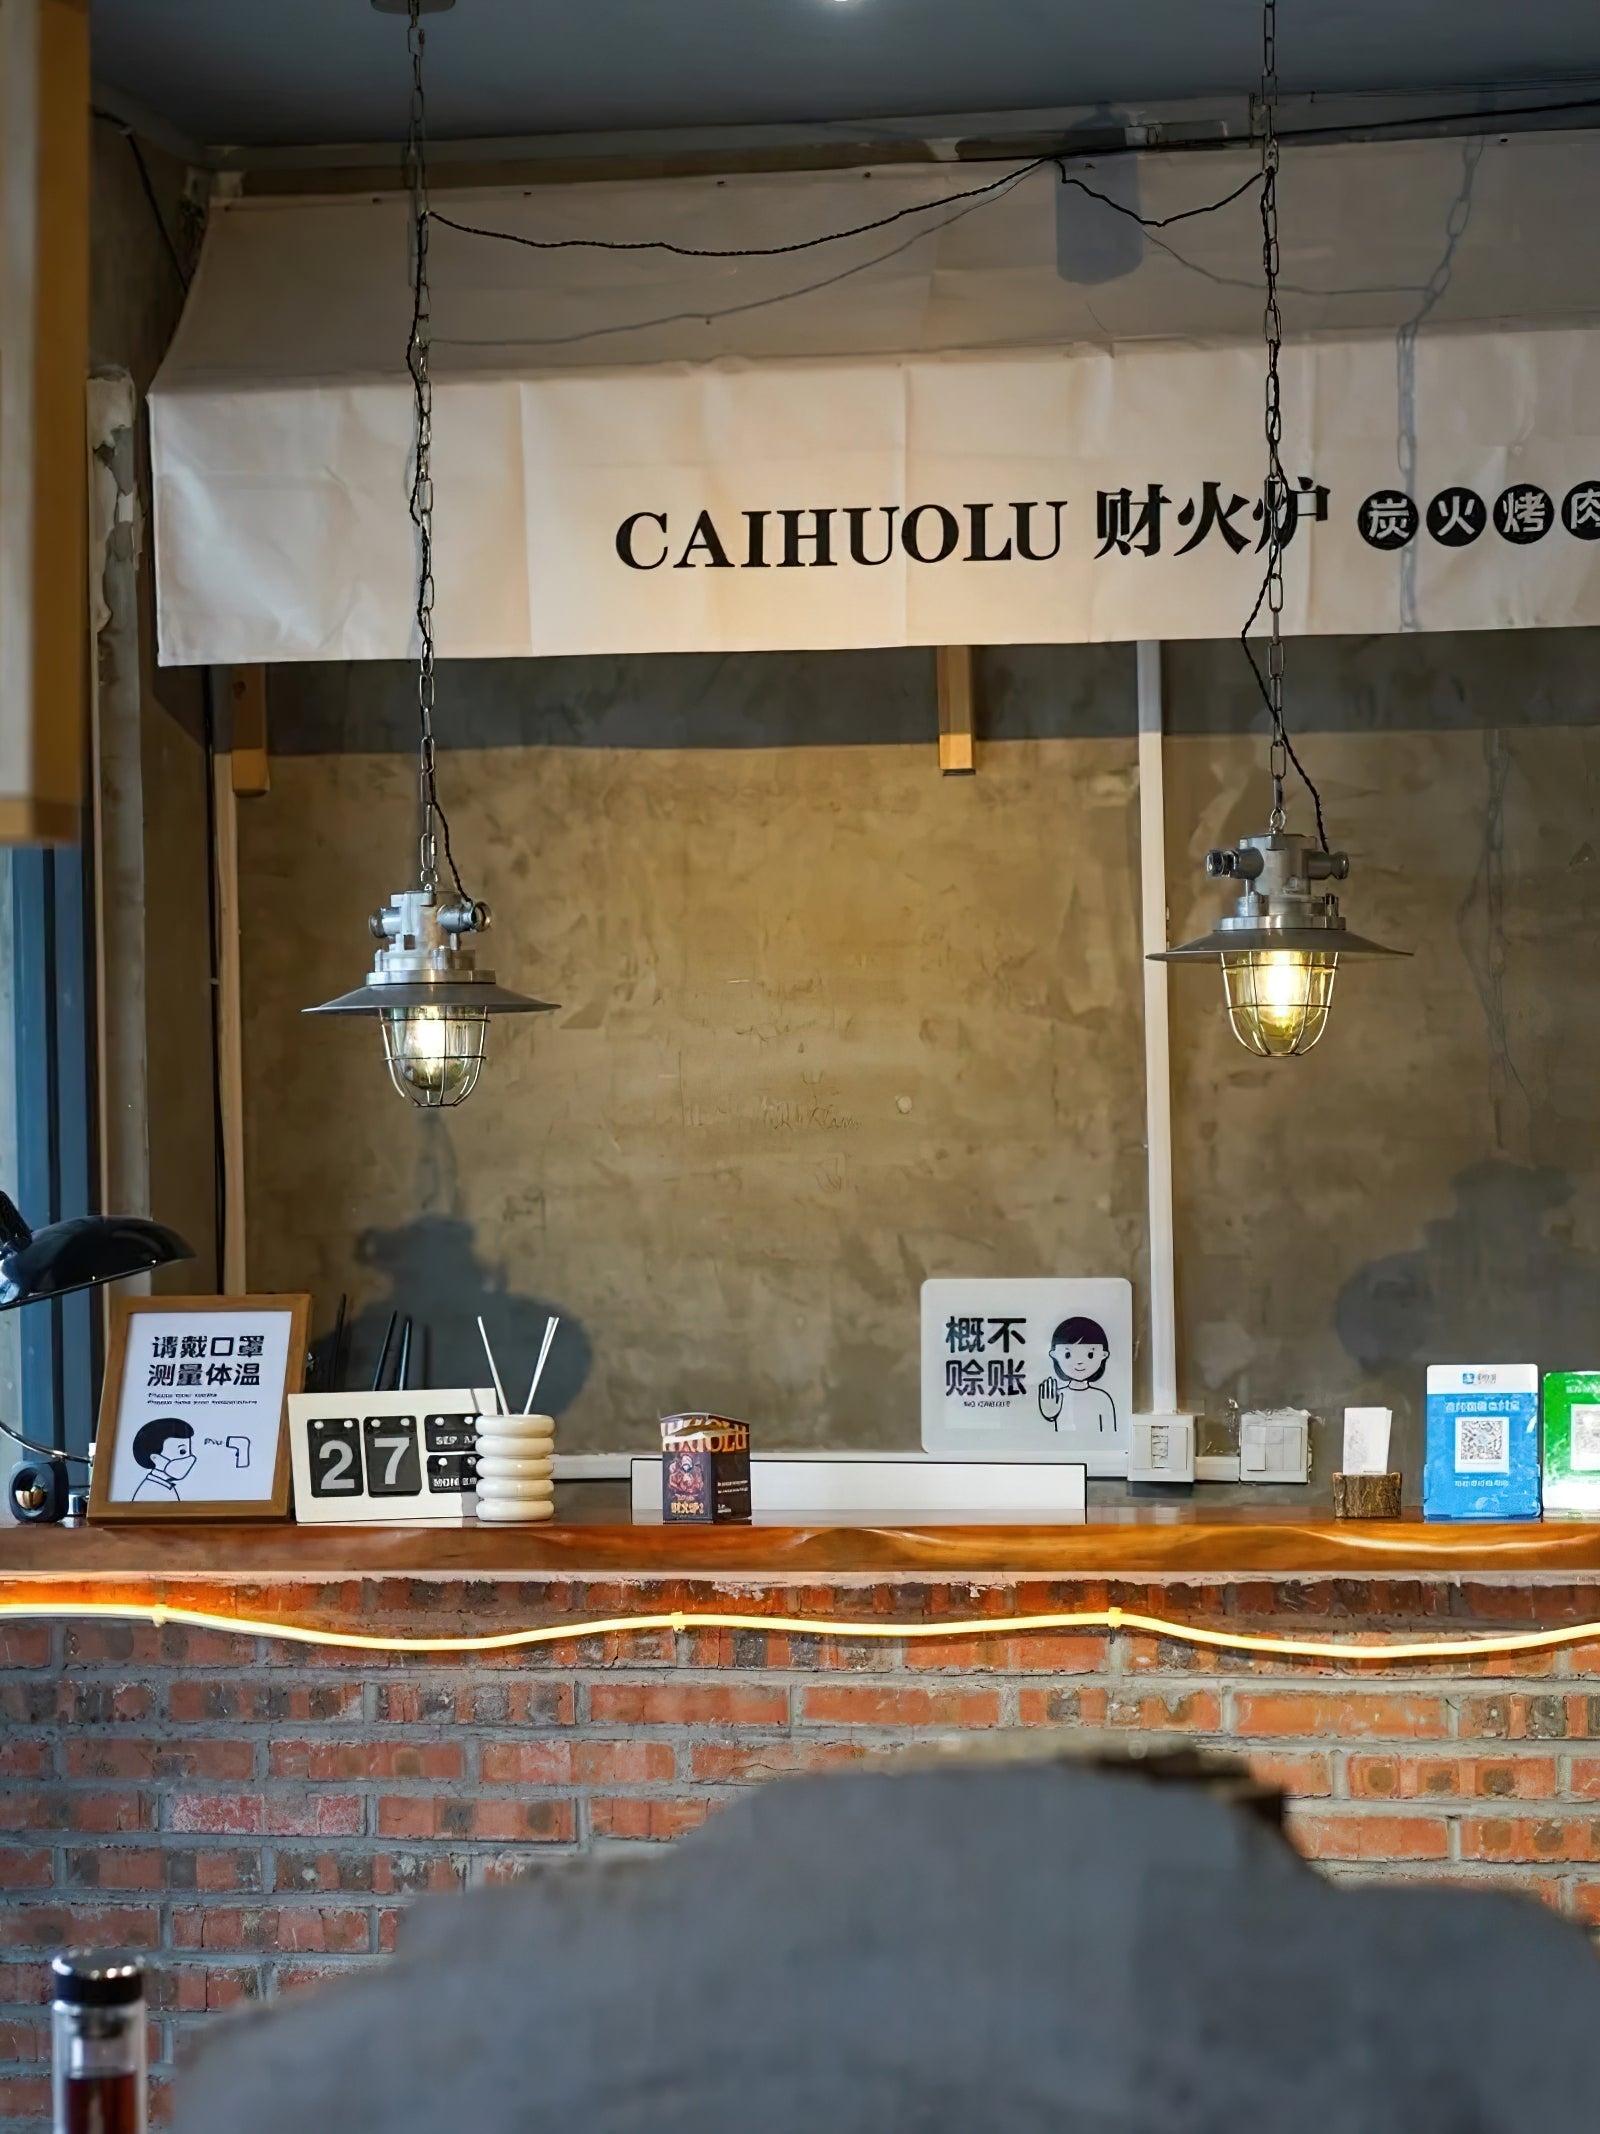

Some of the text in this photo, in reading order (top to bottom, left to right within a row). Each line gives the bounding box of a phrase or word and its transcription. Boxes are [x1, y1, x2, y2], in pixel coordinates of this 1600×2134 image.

[615, 476, 1600, 570] CAIHUOLU 财火炉 炭火烤肉
[152, 1335, 265, 1359] 请戴口罩
[945, 1315, 1027, 1353] 概不
[147, 1363, 260, 1387] 测量体温
[945, 1358, 1027, 1396] 赊账
